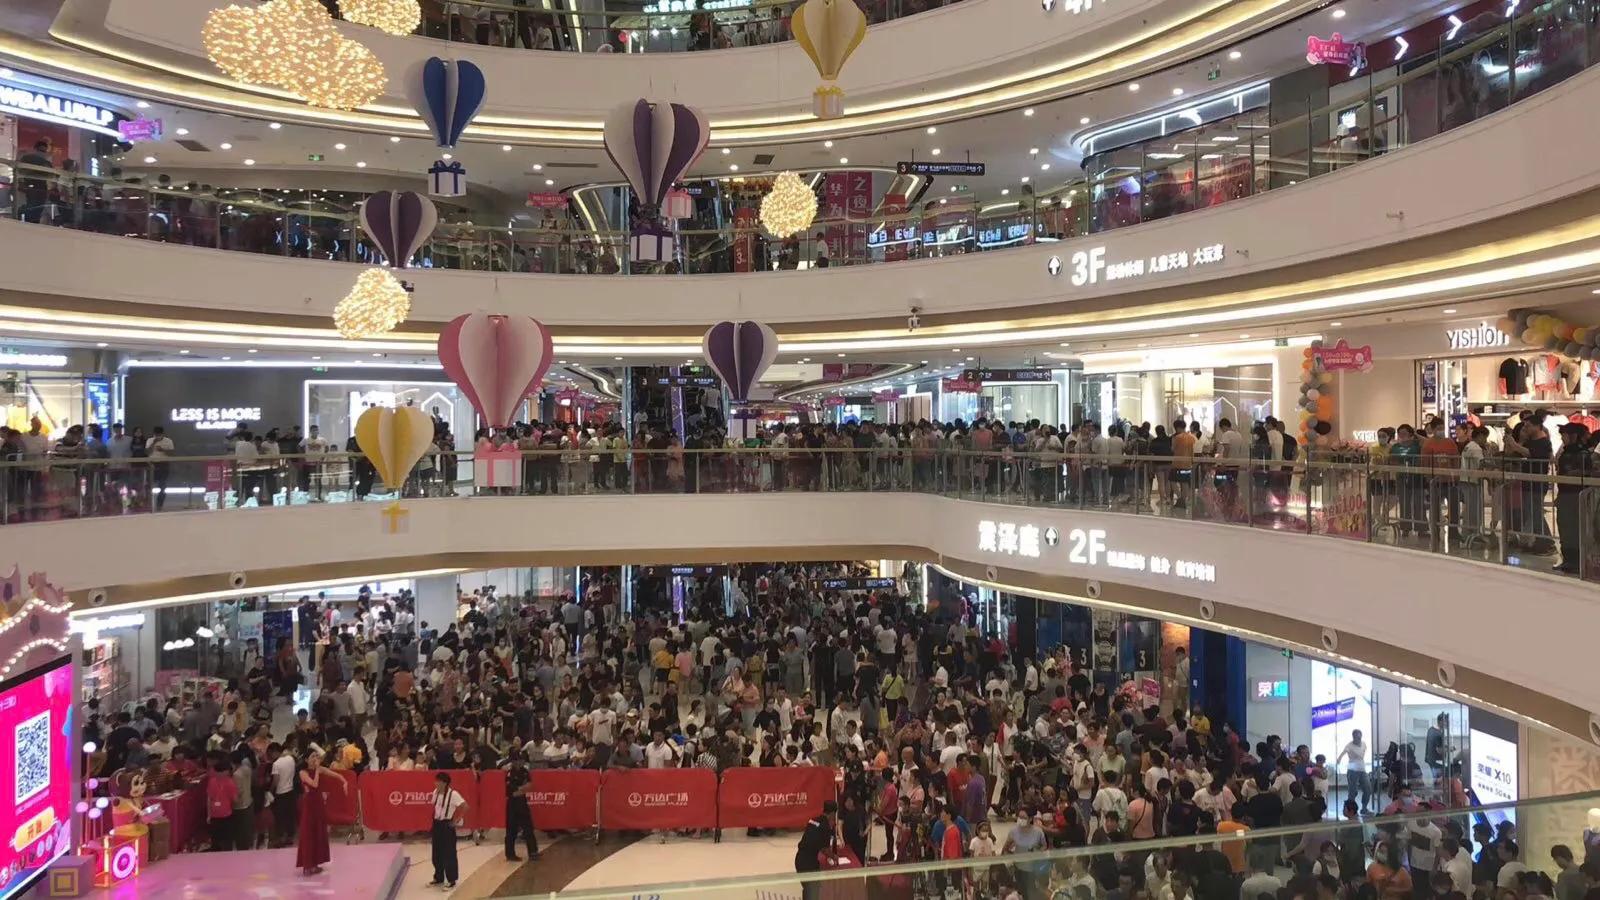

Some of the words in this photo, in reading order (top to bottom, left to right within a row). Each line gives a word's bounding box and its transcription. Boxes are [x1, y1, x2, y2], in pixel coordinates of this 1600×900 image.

[1071, 246, 1106, 286] 3F
[1193, 243, 1225, 265] 大玩家
[171, 408, 204, 421] LESS
[206, 408, 219, 421] IS
[221, 407, 261, 421] MORE
[1069, 528, 1106, 565] 2F
[1139, 650, 1146, 668] 3
[404, 791, 434, 801] 万达广
[643, 792, 689, 802] 万达广场
[763, 791, 807, 803] 万达广场
